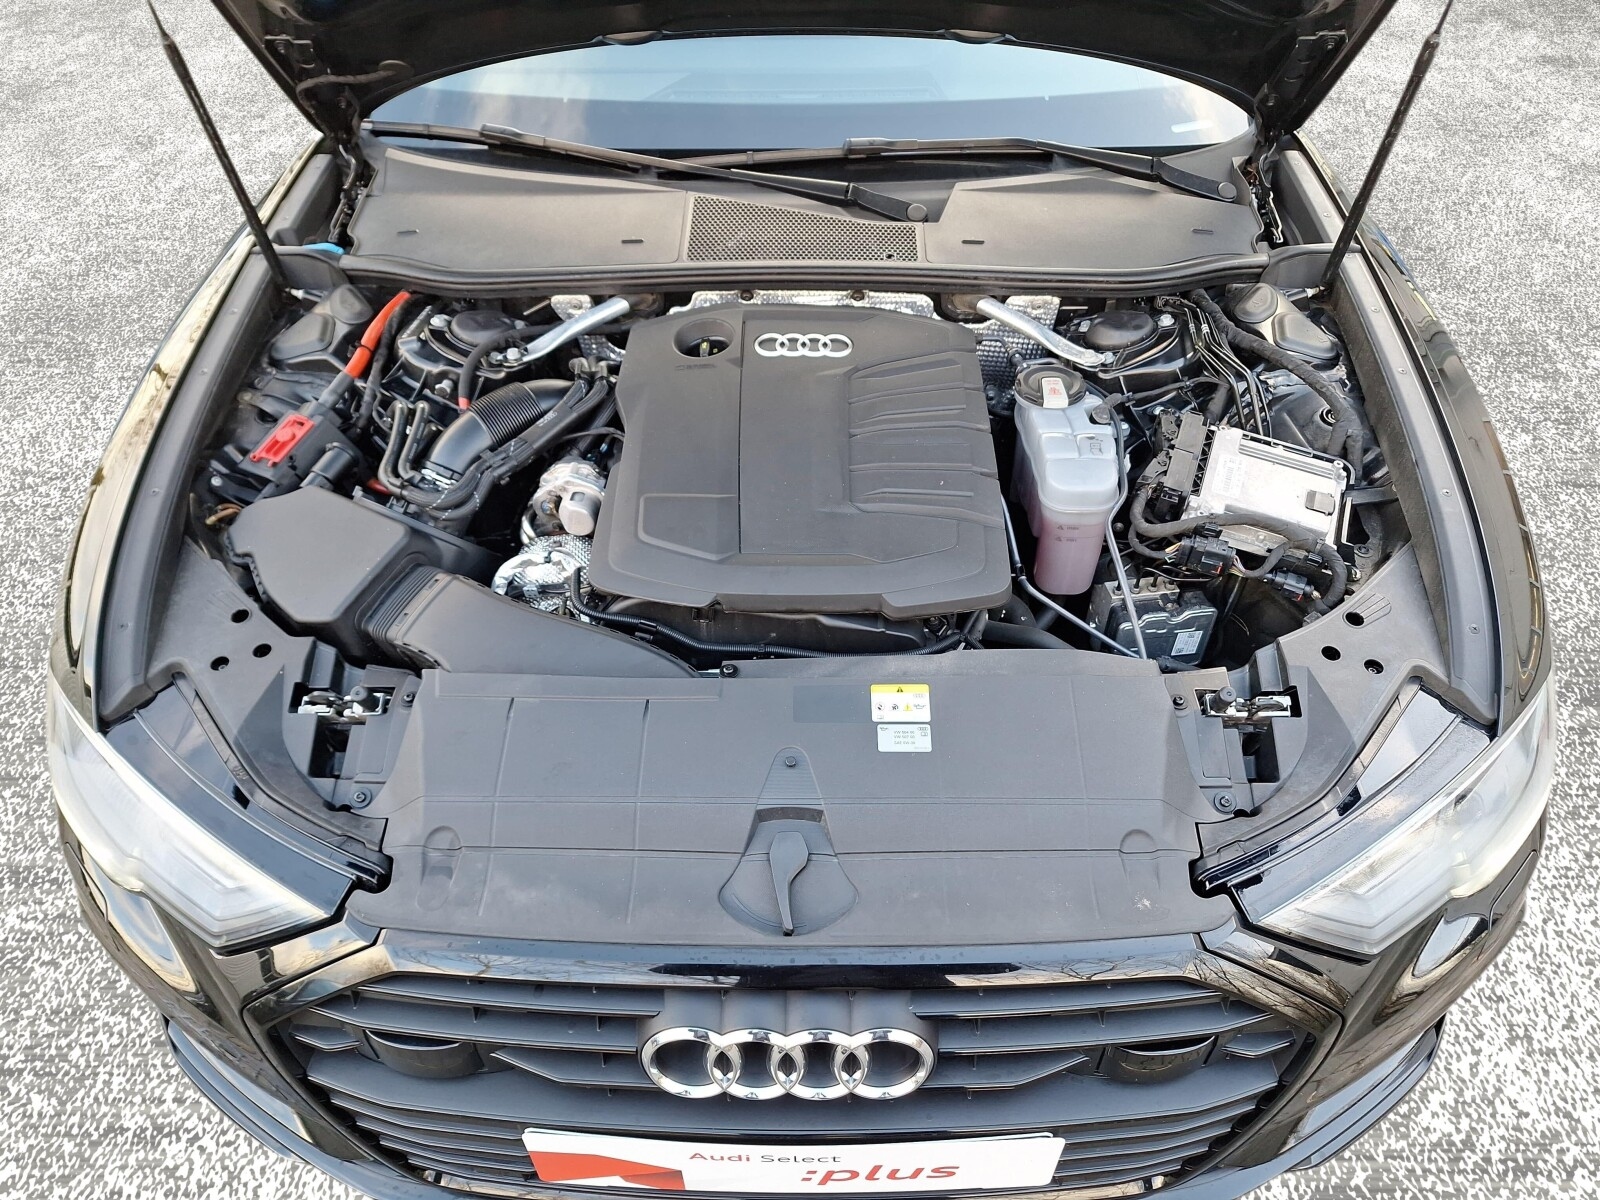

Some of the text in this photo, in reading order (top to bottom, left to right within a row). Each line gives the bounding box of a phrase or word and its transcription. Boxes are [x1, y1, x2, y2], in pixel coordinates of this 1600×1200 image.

[689, 1152, 841, 1163] Audi Select
[801, 1165, 960, 1186] :plus
